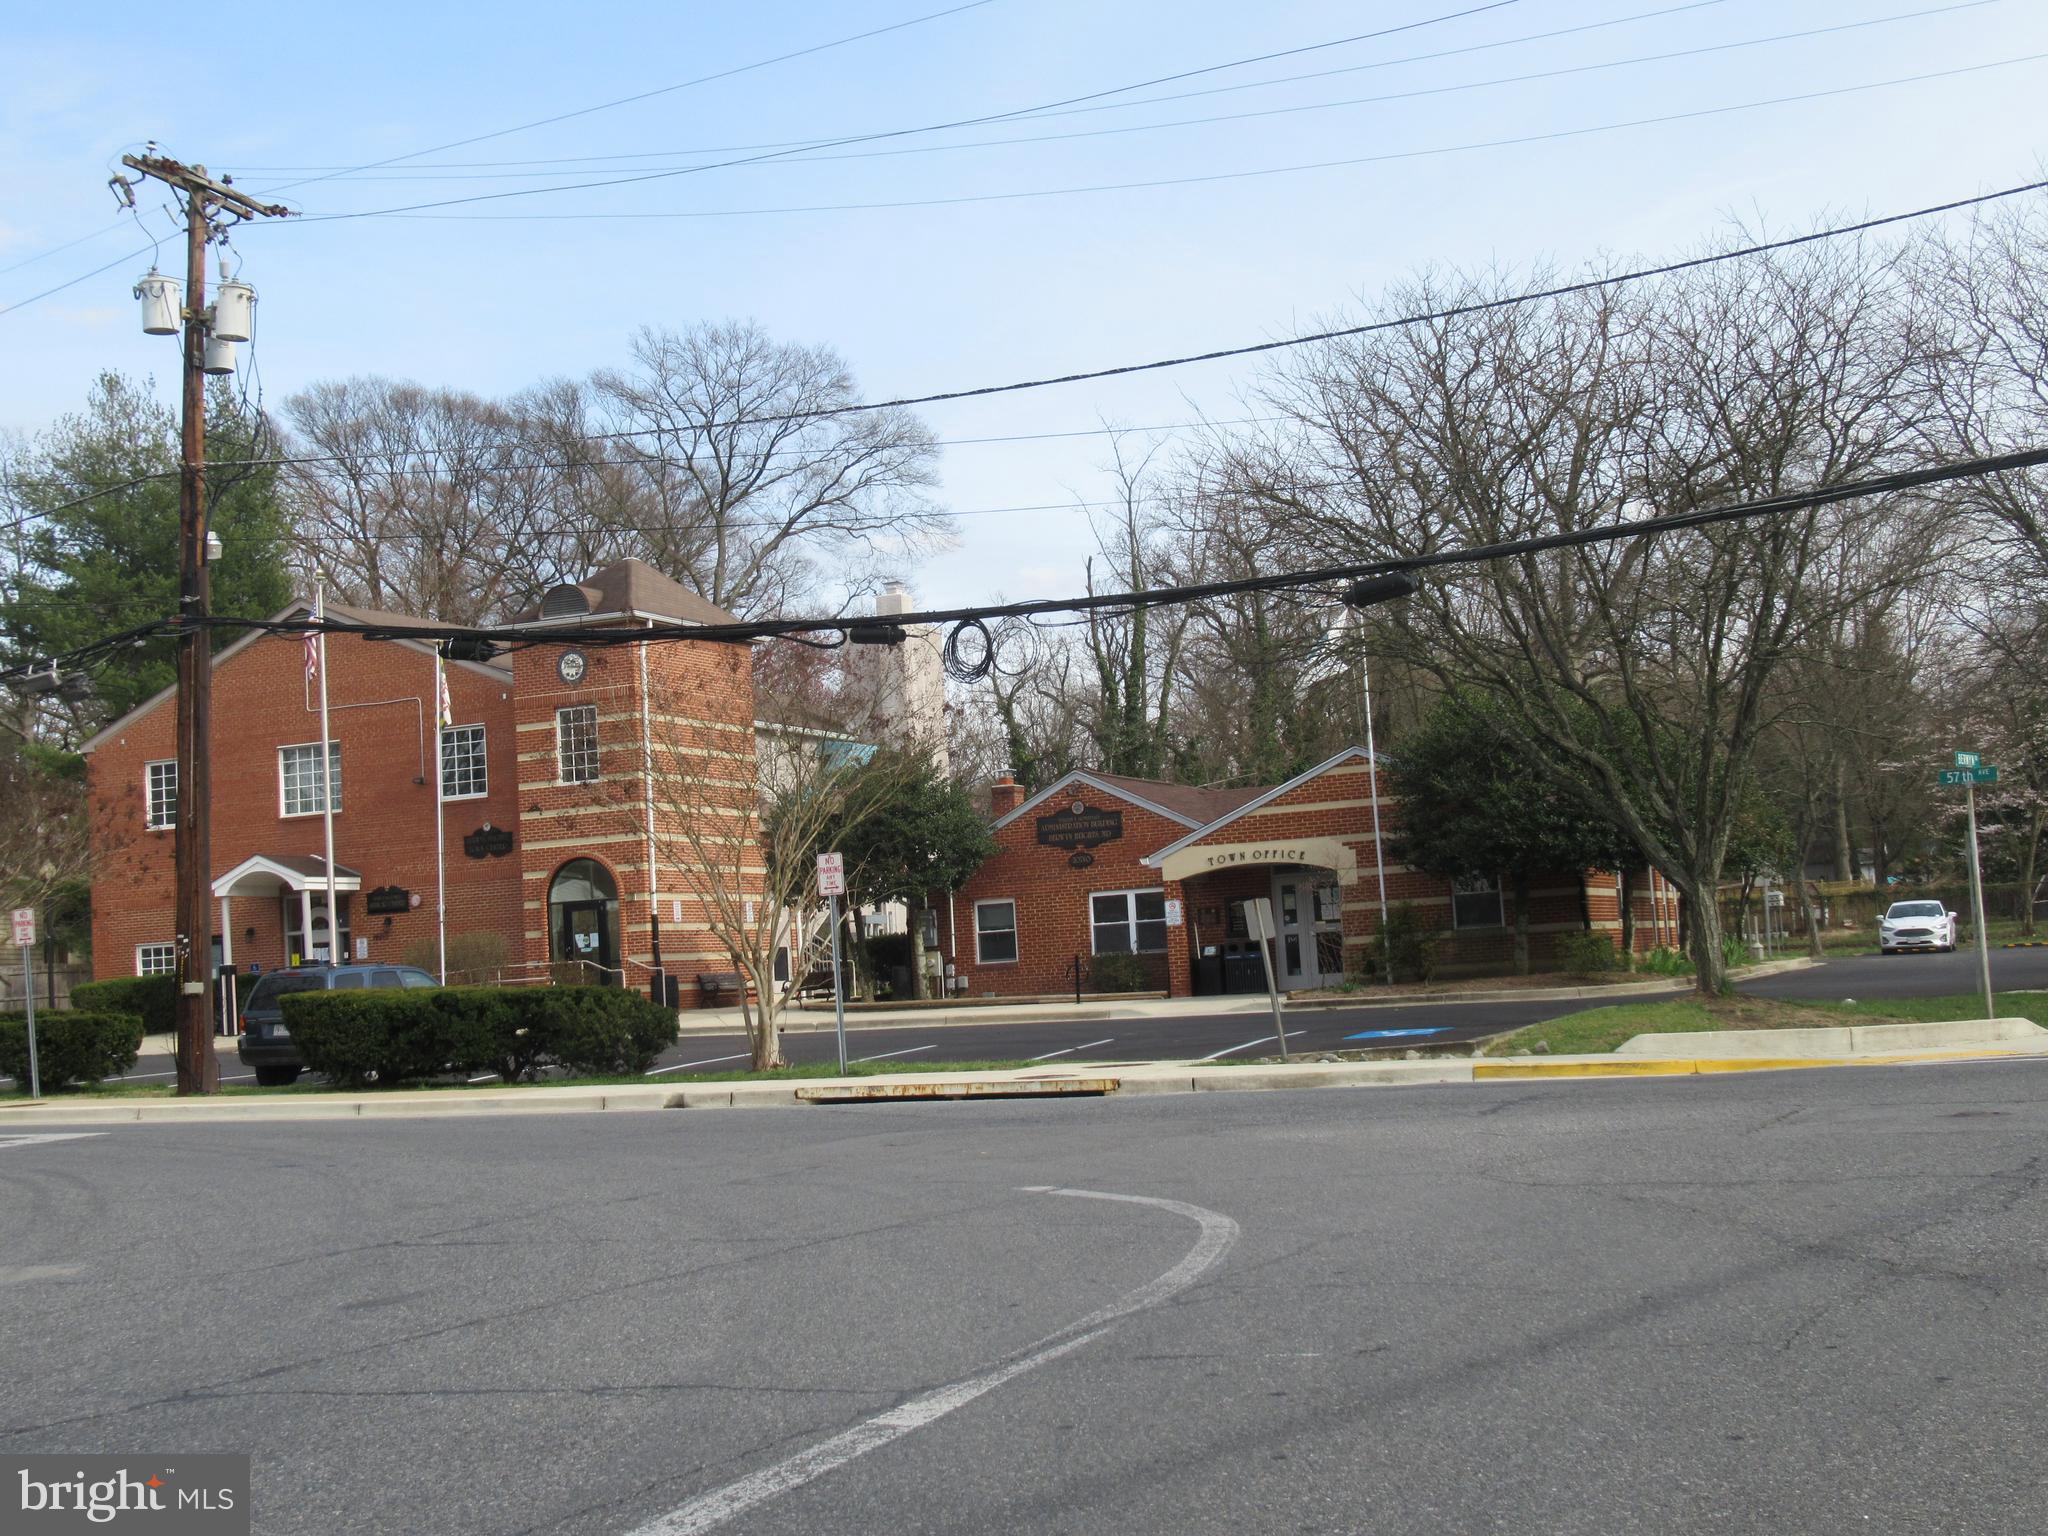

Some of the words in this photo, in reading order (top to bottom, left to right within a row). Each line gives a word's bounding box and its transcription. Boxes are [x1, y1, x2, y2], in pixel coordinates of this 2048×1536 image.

[824, 856, 835, 865] NO
[1207, 851, 1246, 866] TOWN
[1252, 849, 1306, 860] OFFICE
[819, 865, 842, 875] PARKING
